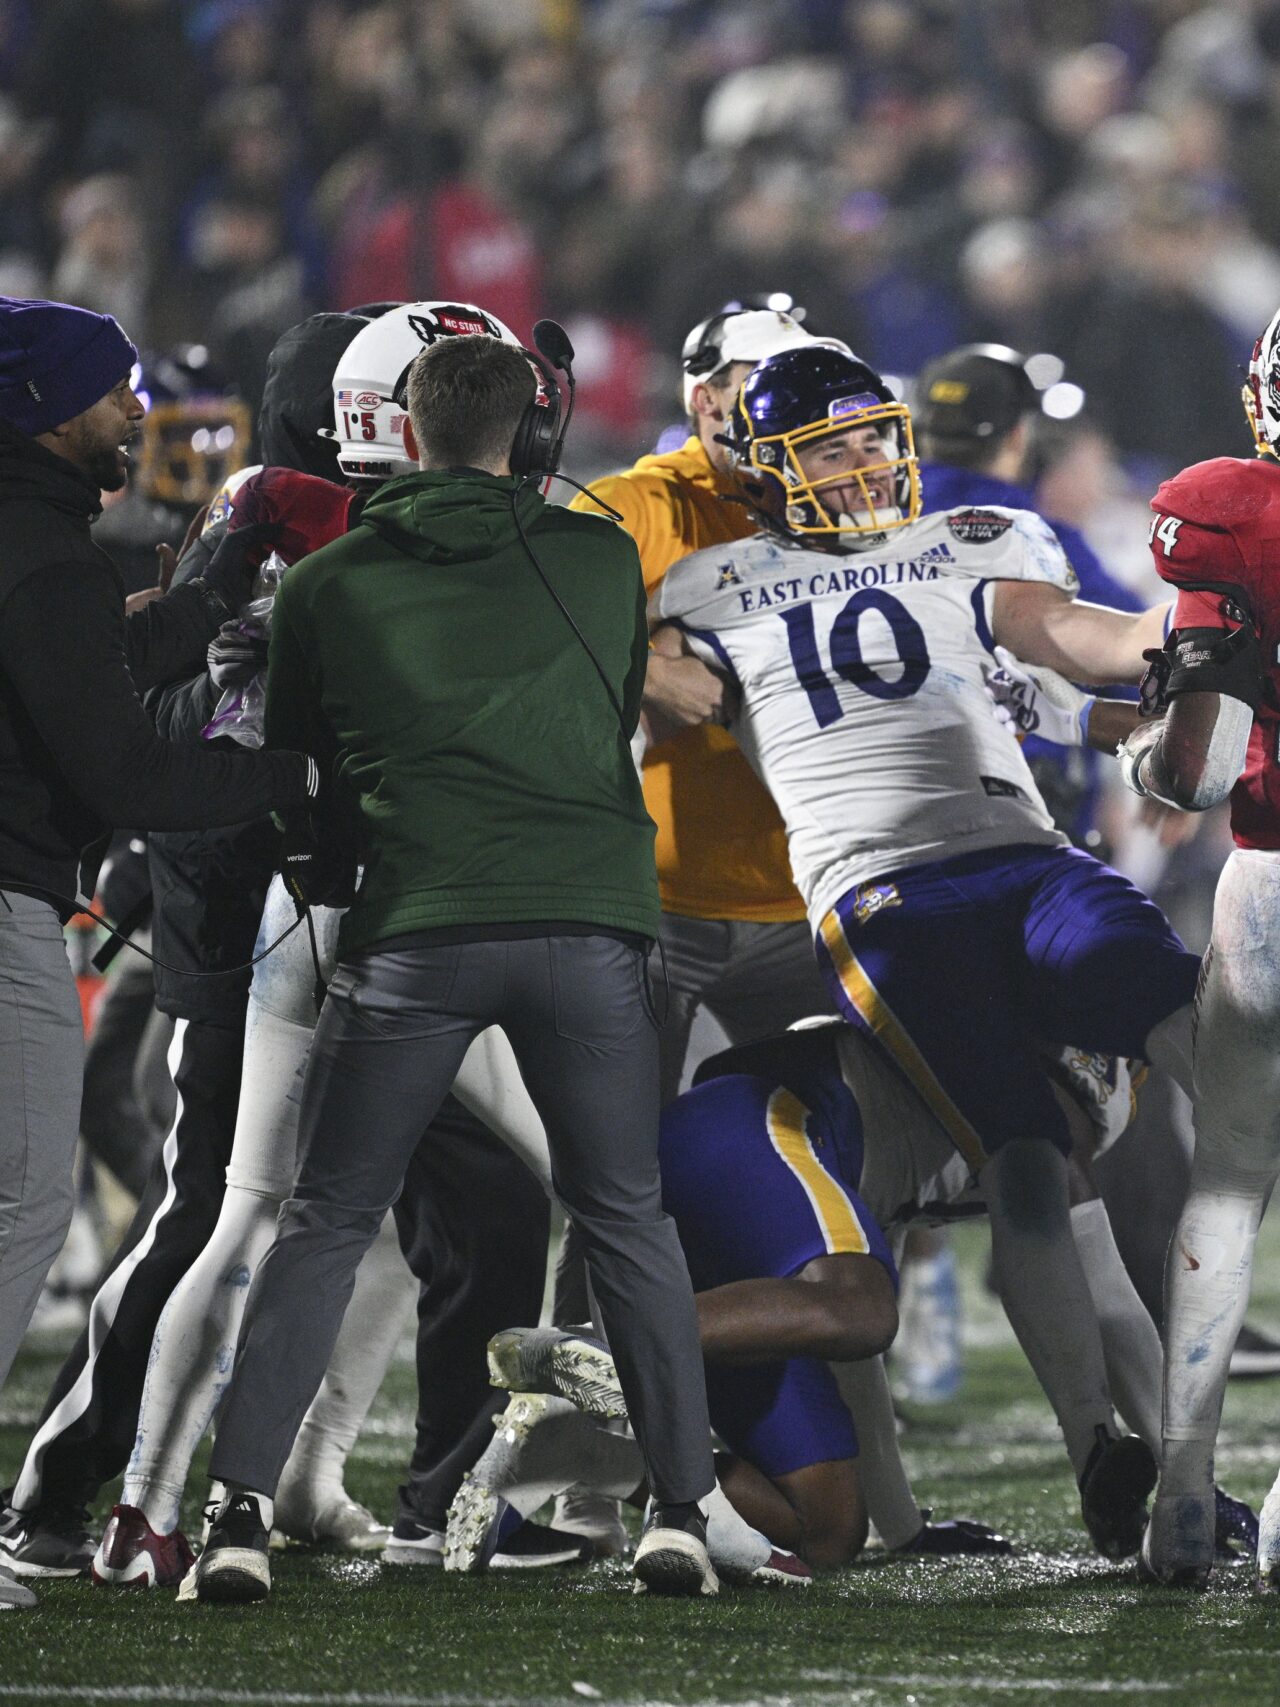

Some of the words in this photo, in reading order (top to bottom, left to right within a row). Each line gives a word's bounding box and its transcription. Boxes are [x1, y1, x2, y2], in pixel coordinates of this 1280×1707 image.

[444, 317, 459, 330] NC
[459, 321, 484, 333] STATE
[358, 395, 378, 405] ACC
[738, 577, 802, 613] EAST
[809, 561, 940, 597] CAROLINA
[777, 587, 932, 730] 10
[1182, 650, 1212, 664] GEAR
[286, 853, 313, 862] verizon
